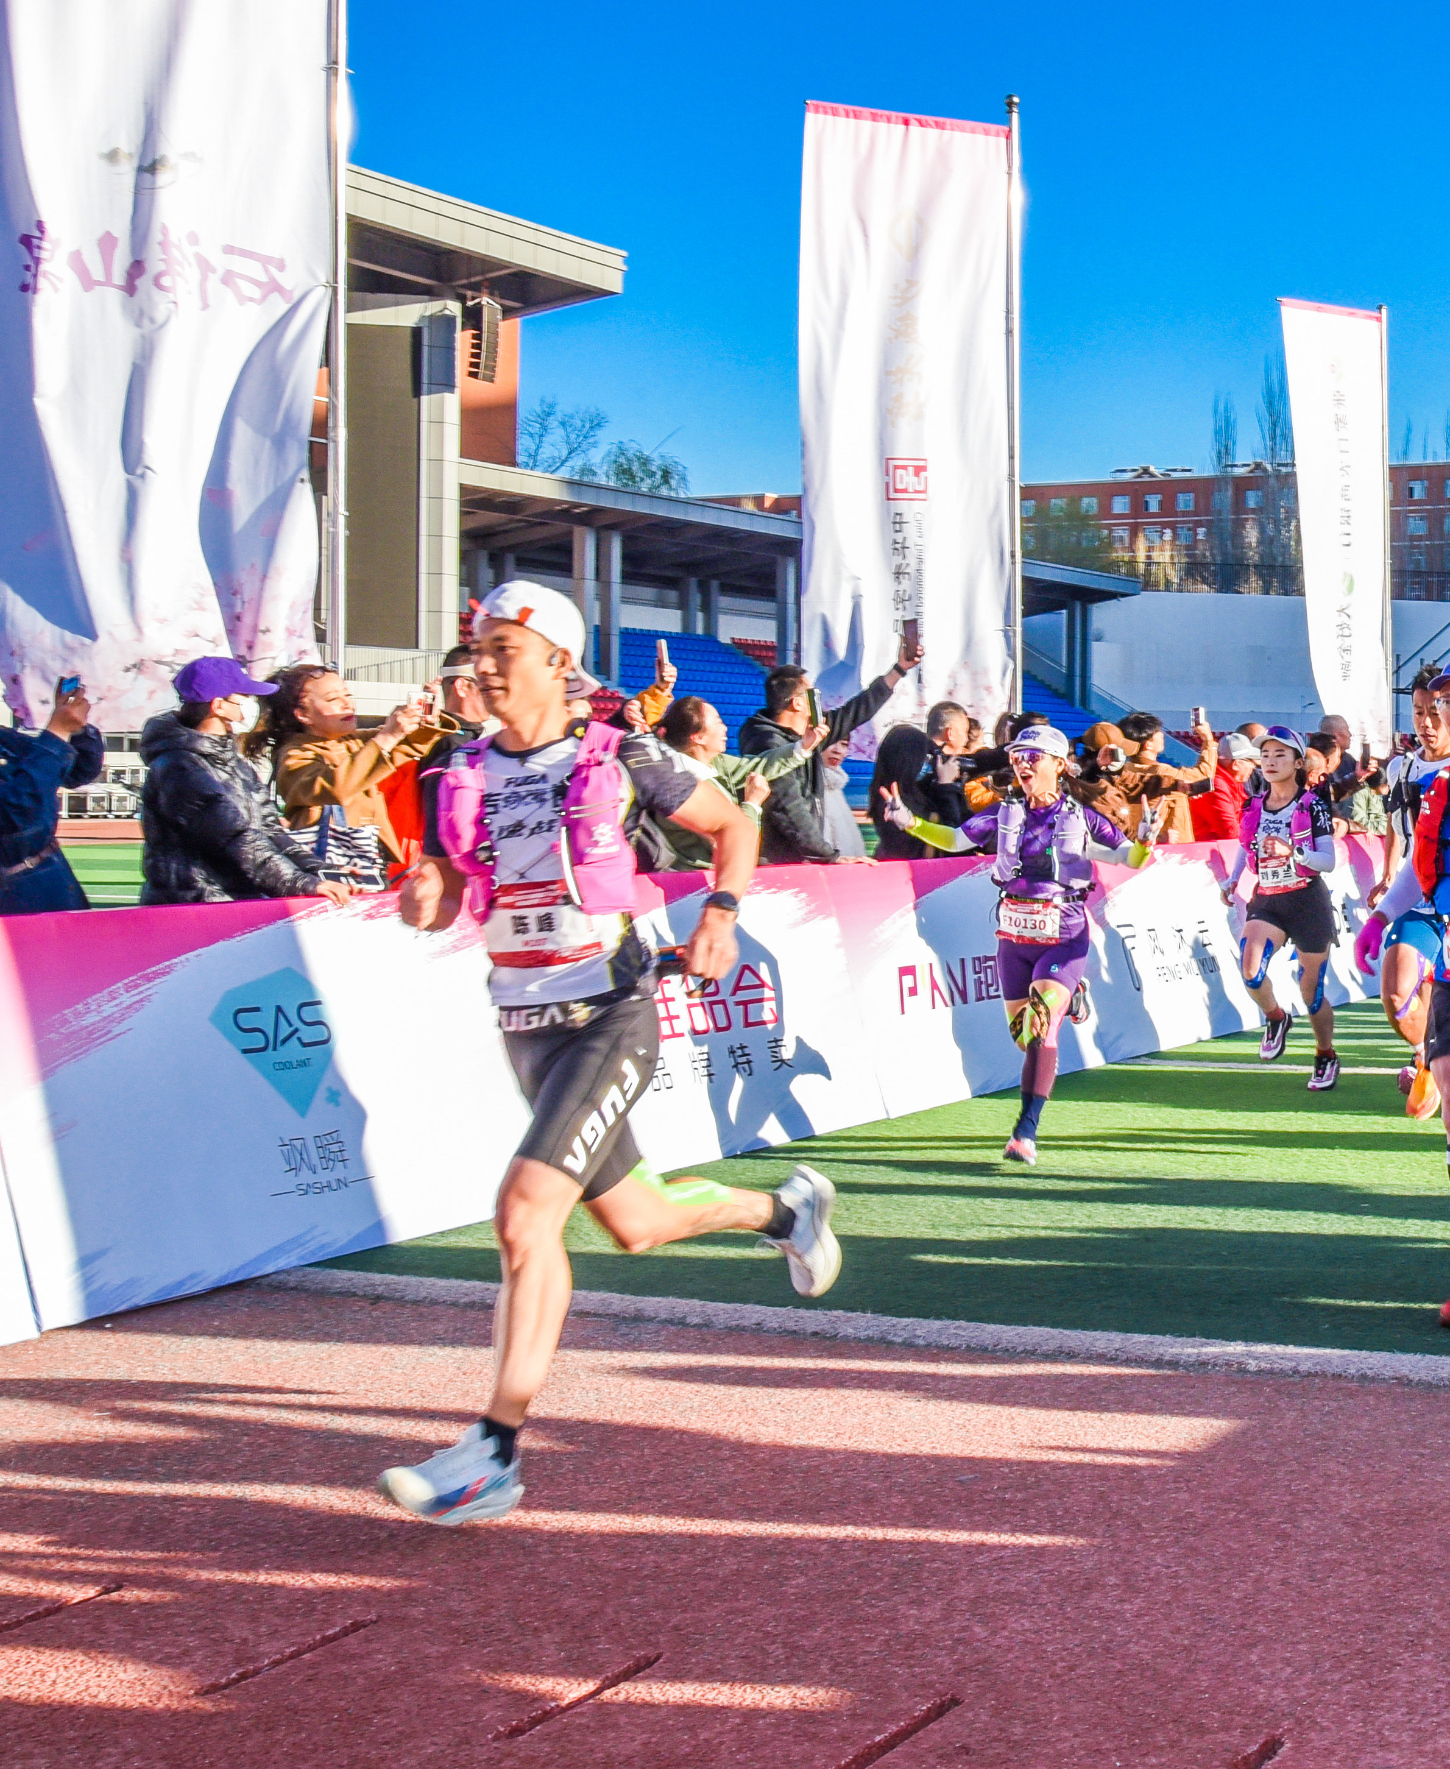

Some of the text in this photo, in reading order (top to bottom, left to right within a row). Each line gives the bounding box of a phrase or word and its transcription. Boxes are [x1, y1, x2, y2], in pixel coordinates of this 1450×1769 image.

[1002, 914, 1047, 931] F10130
[233, 1000, 331, 1054] SAS
[502, 1004, 566, 1032] UGA
[273, 1058, 313, 1071] COOLANT
[651, 1036, 795, 1093] 品牌特卖
[563, 1058, 640, 1175] FUGA
[277, 1129, 351, 1177] 飒瞬
[295, 1176, 350, 1196] SASHUN
